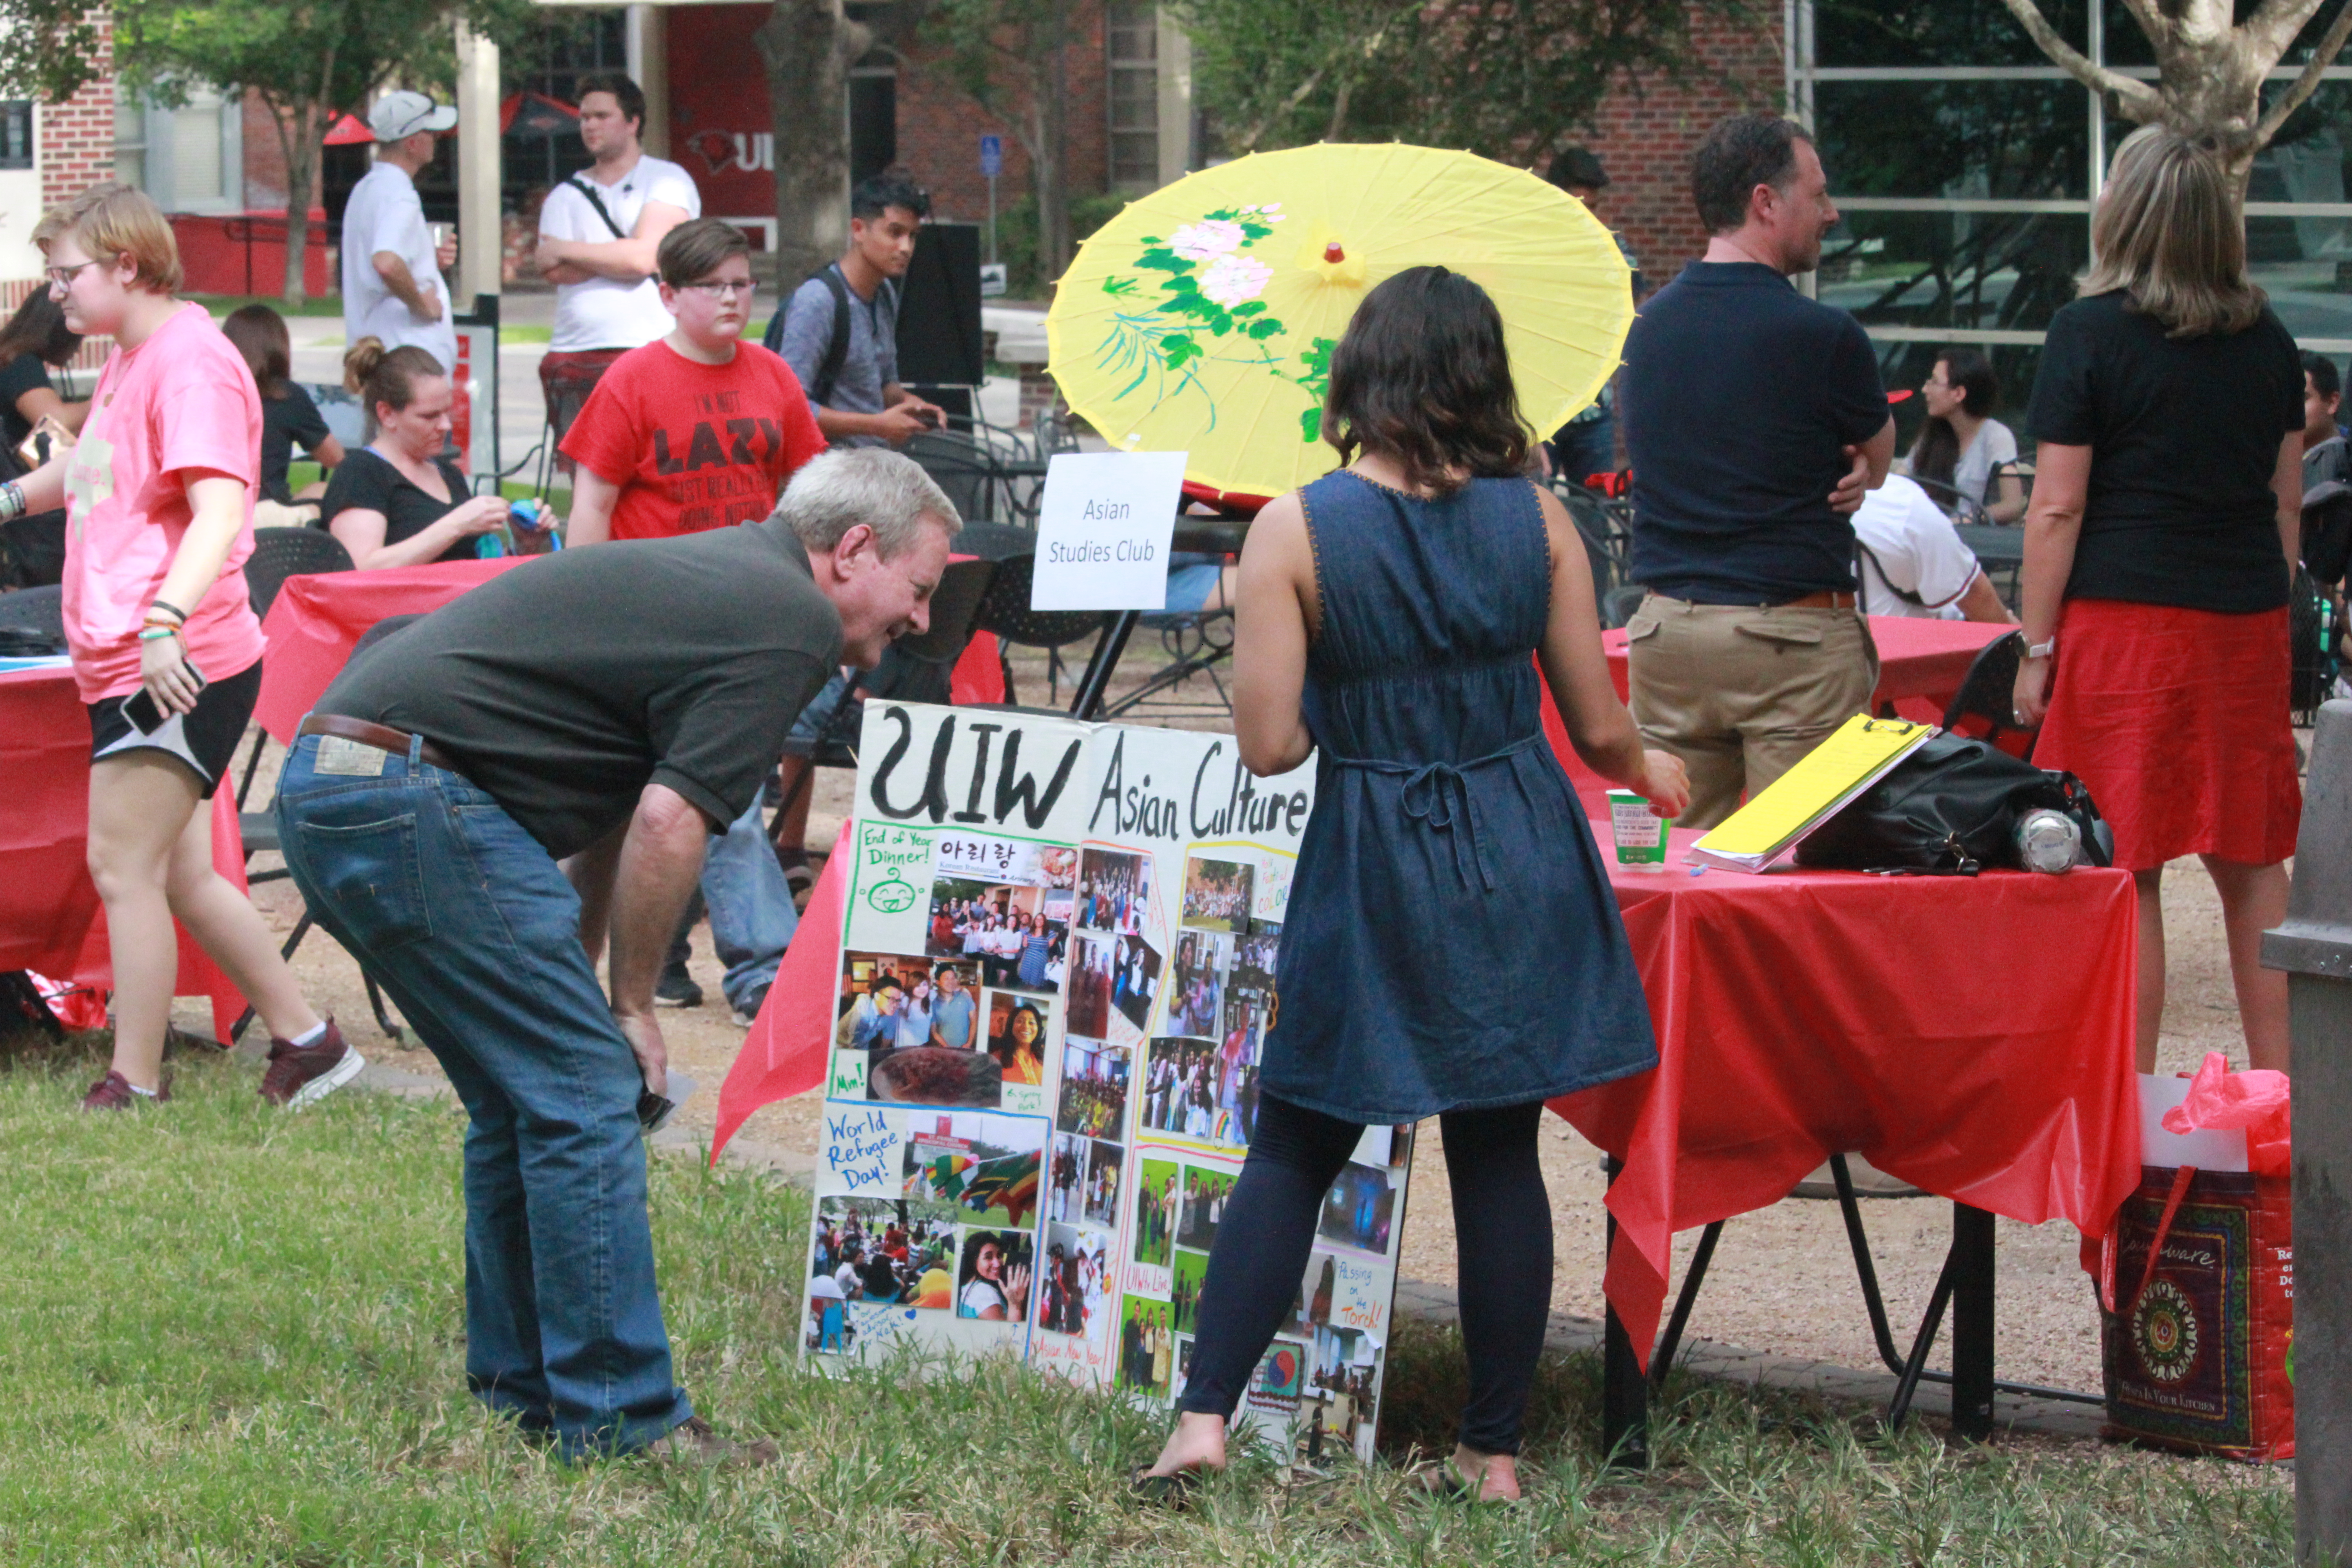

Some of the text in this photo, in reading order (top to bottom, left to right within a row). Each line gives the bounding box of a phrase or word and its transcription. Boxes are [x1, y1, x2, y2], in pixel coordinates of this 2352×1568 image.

[715, 390, 741, 414] NOT
[653, 417, 781, 476] LAZY
[1083, 498, 1130, 520] Asian
[1049, 539, 1155, 563] Studies Club
[871, 706, 1308, 841] UIW Asian Culture
[864, 828, 934, 849] End of Year
[867, 848, 930, 865] Dinner!
[941, 840, 1016, 869] 아리랑
[940, 861, 1000, 874] Korean Restaurant
[827, 1110, 887, 1142] World
[827, 1132, 898, 1171] Refugee
[917, 1137, 946, 1146] EPISCOPAL
[841, 1157, 889, 1191] Day!
[1152, 1266, 1174, 1295] Live!
[1338, 1261, 1372, 1286] Passing
[1350, 1287, 1358, 1296] on
[1356, 1297, 1367, 1309] the
[1342, 1300, 1383, 1329] Torch!
[1036, 1334, 1061, 1359] Asian
[1064, 1338, 1082, 1360] New
[1086, 1344, 1102, 1366] Year
[2154, 1390, 2177, 1405] YOUR
[2179, 1393, 2215, 1412] KITCHEN
